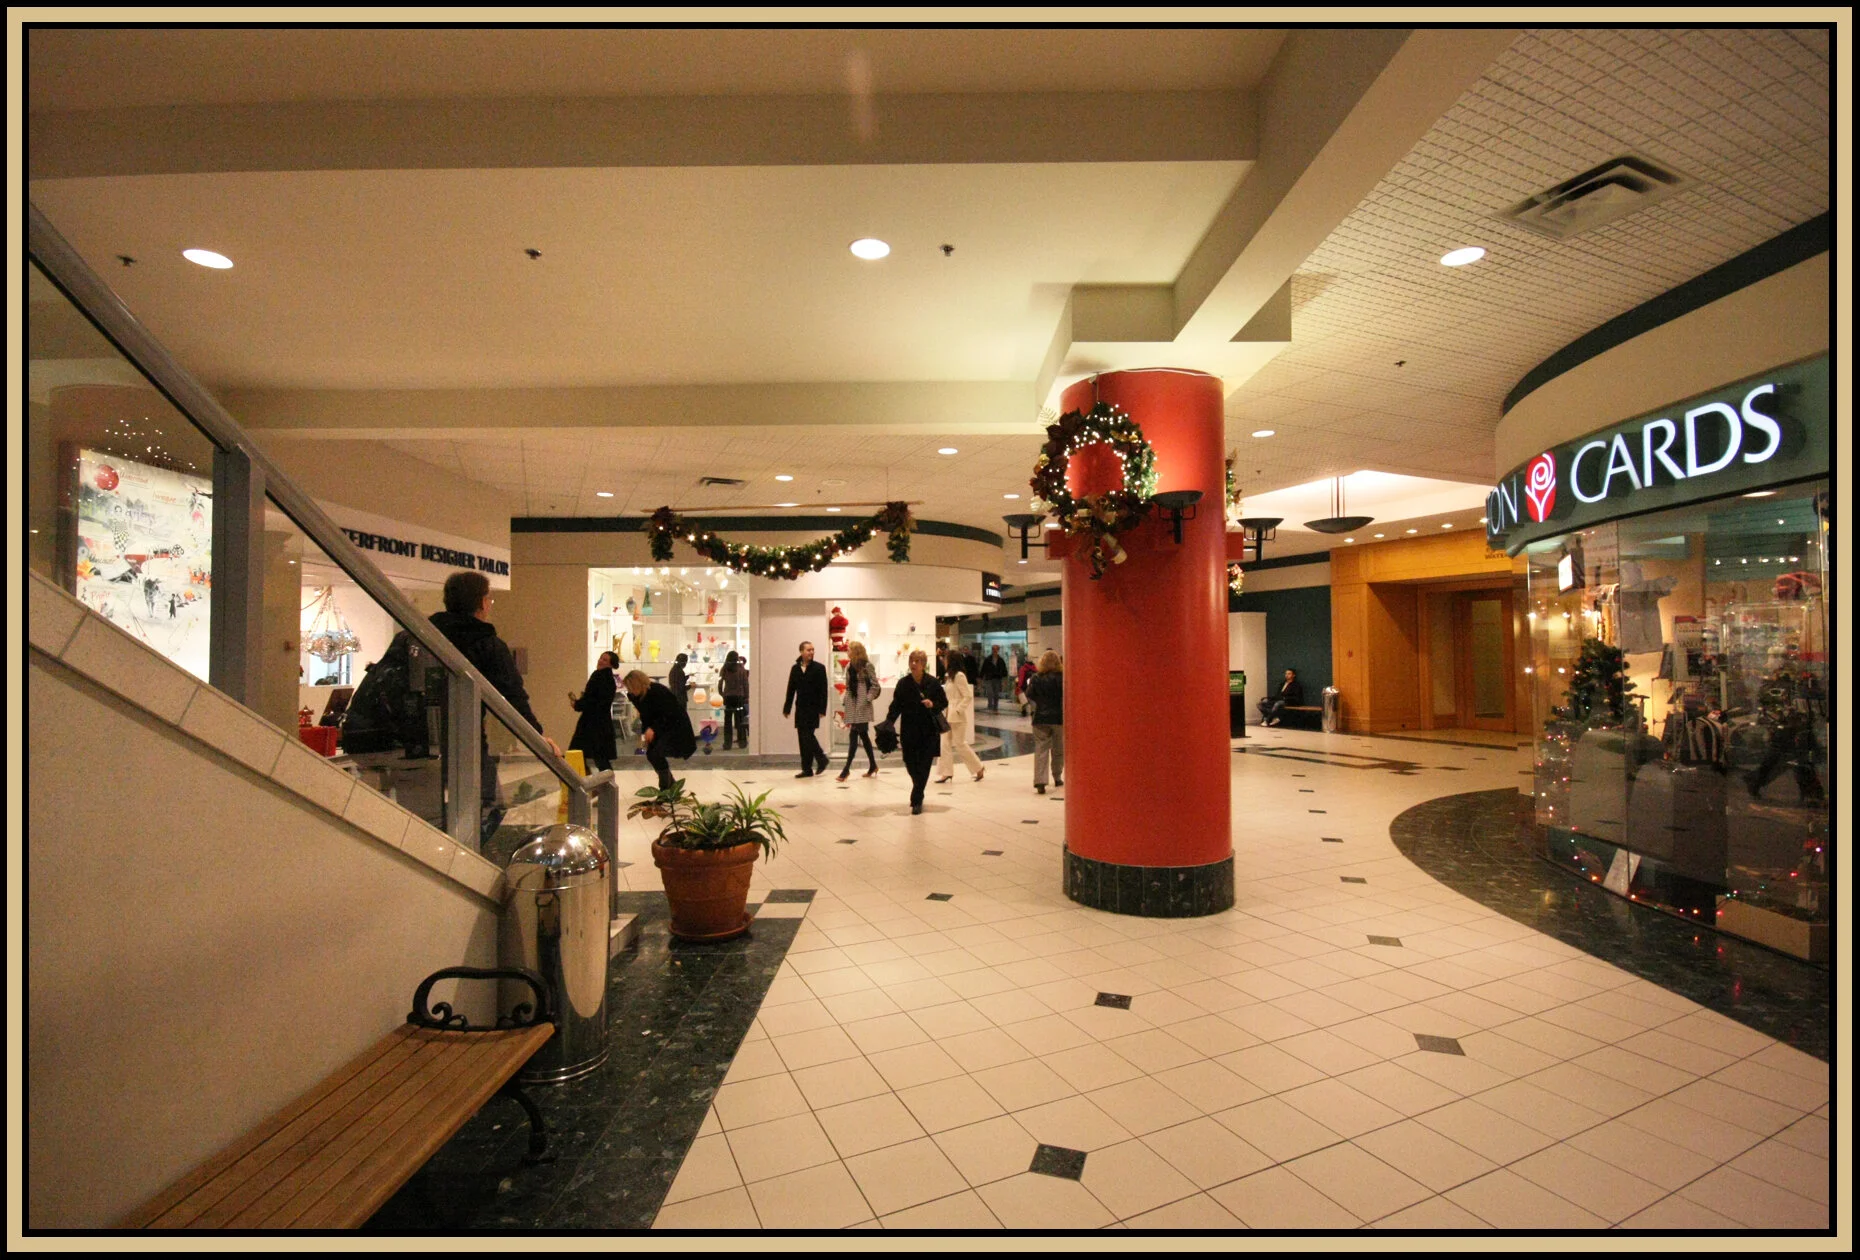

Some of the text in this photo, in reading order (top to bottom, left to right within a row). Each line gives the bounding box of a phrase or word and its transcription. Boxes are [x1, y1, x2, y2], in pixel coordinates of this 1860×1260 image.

[1487, 383, 1784, 540] ON CARDS
[421, 543, 476, 570] DESIGNER
[477, 555, 509, 576] TAILOR
